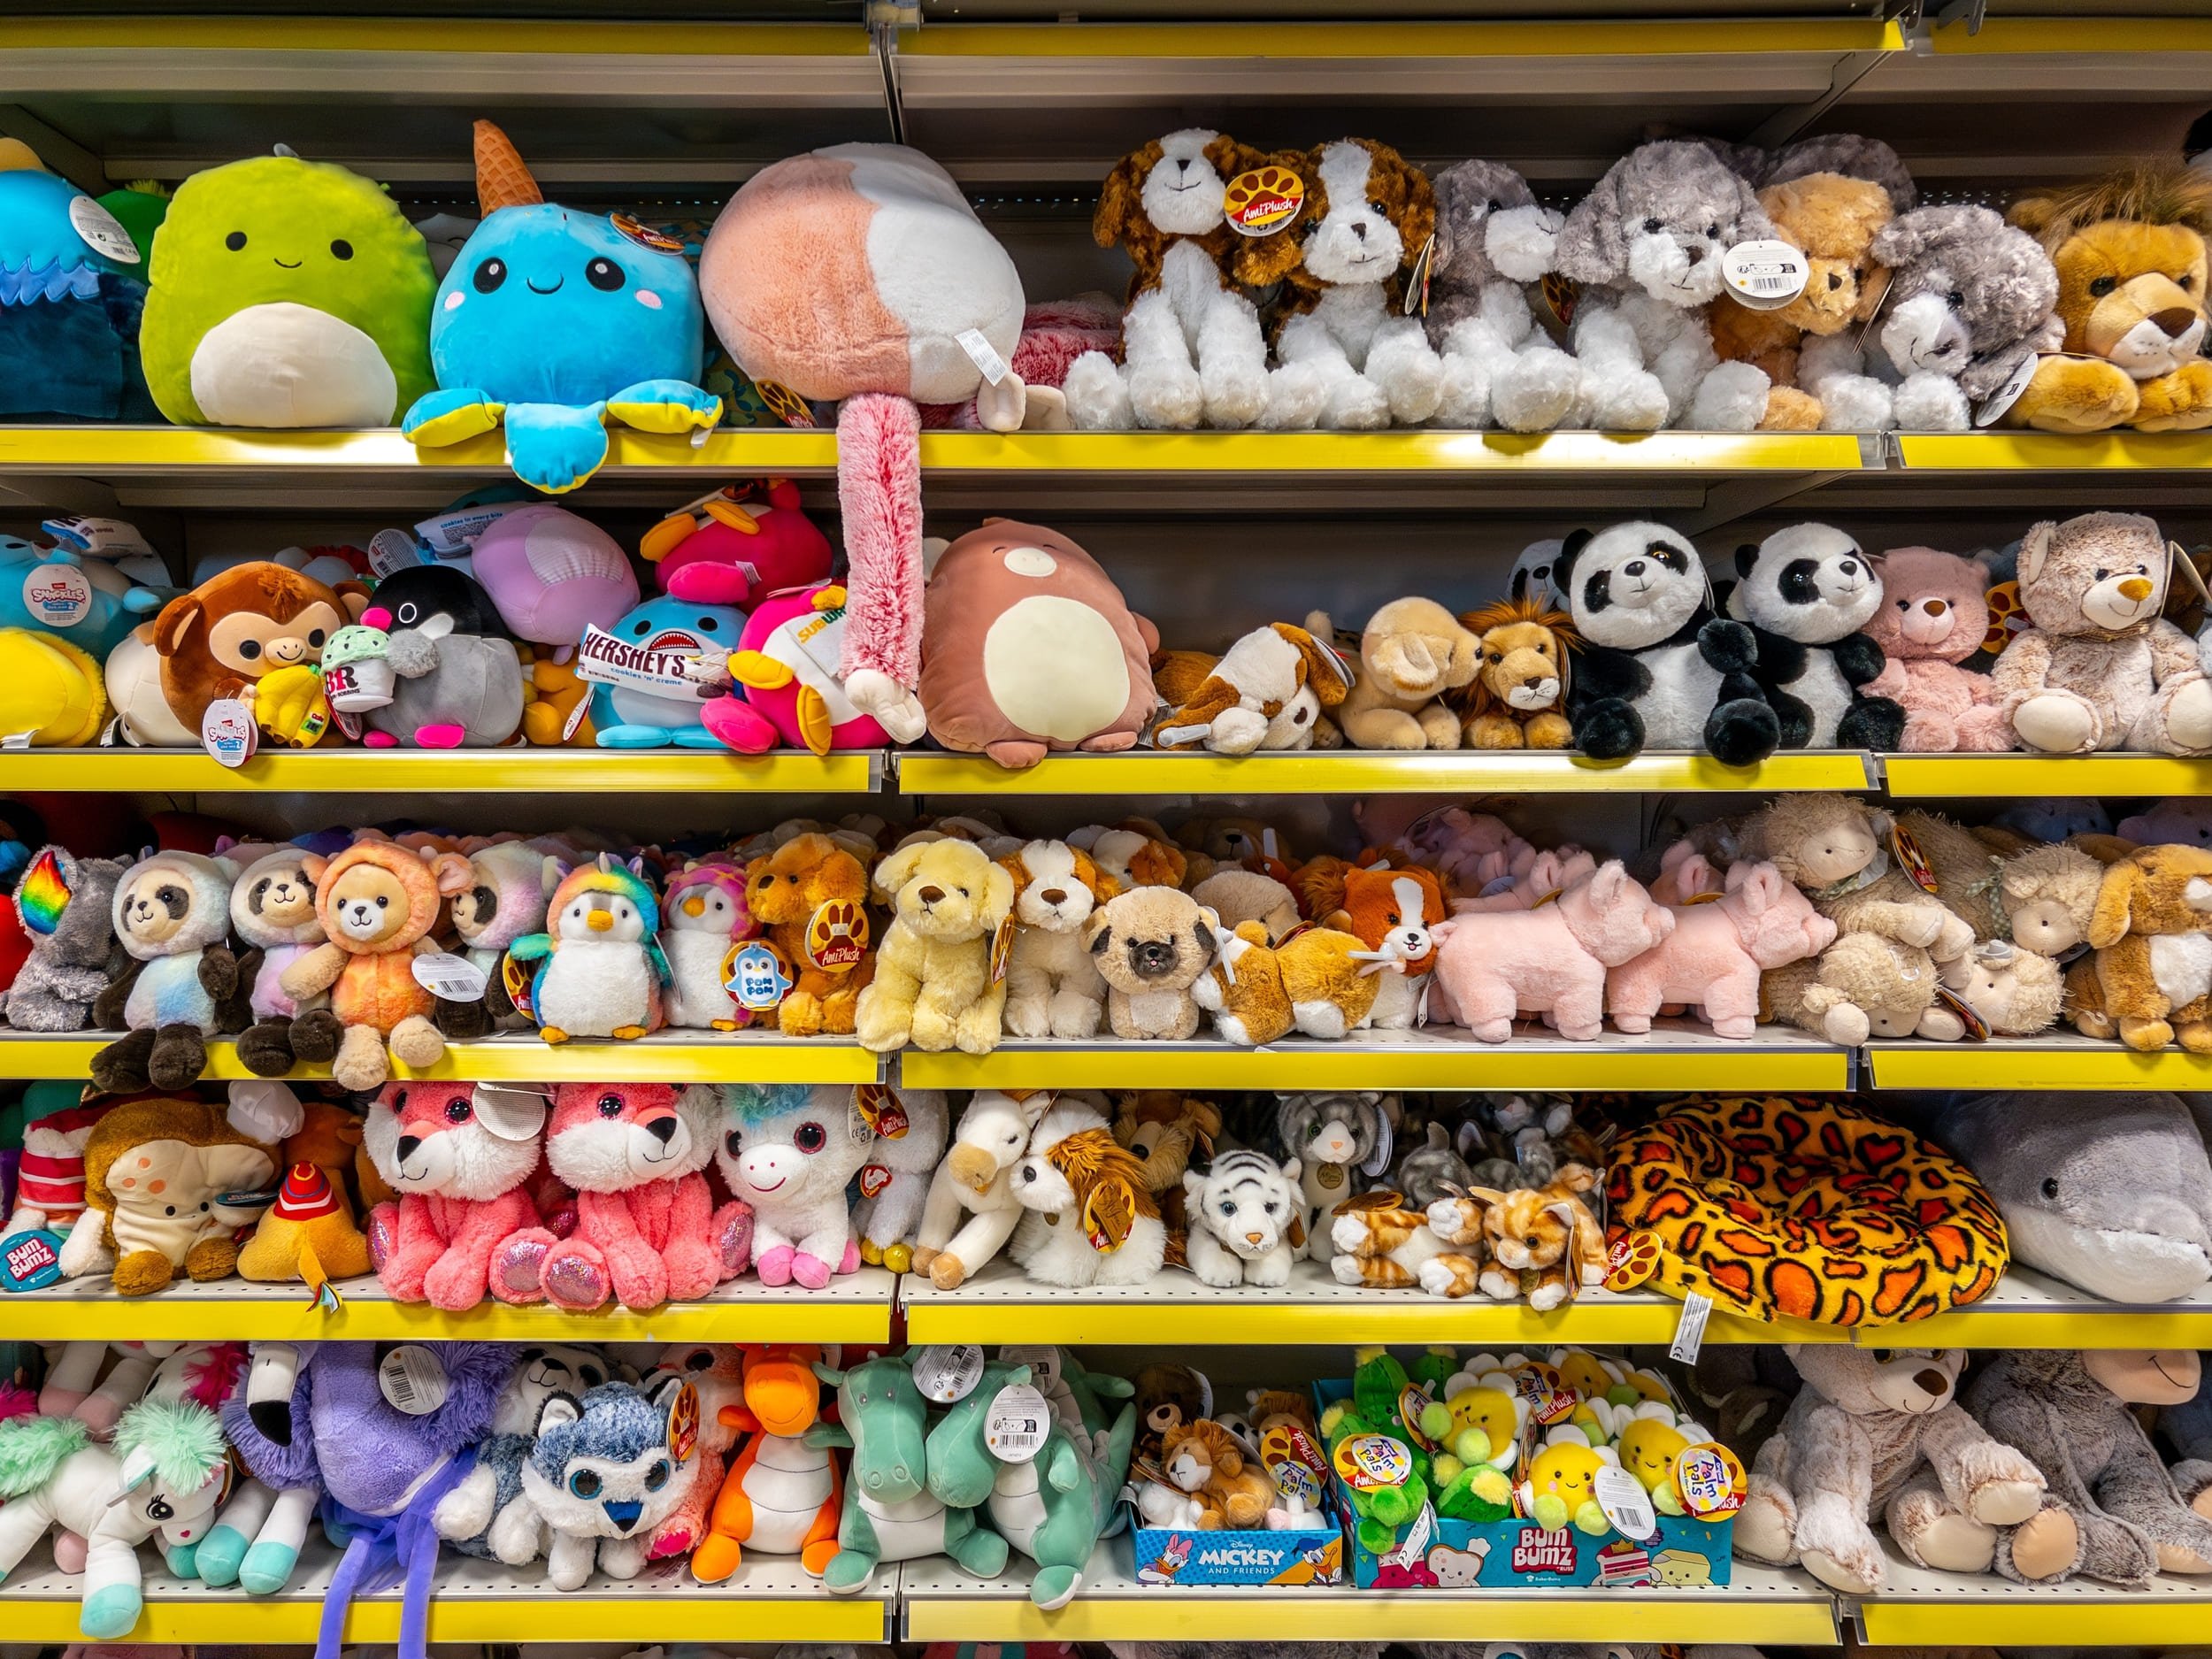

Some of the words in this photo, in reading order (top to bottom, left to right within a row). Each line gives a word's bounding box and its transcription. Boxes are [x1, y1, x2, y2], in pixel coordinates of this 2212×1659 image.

[1243, 198, 1294, 223] AmiPlush
[797, 605, 847, 645] SUBWA
[580, 632, 687, 678] HERSHEY'S
[611, 666, 642, 680] cookies
[656, 677, 683, 687] creme
[822, 947, 860, 967] AmiPlush
[1701, 1460, 1717, 1498] Palm
[1229, 1540, 1254, 1549] Disney
[1198, 1549, 1285, 1566] MICKEY
